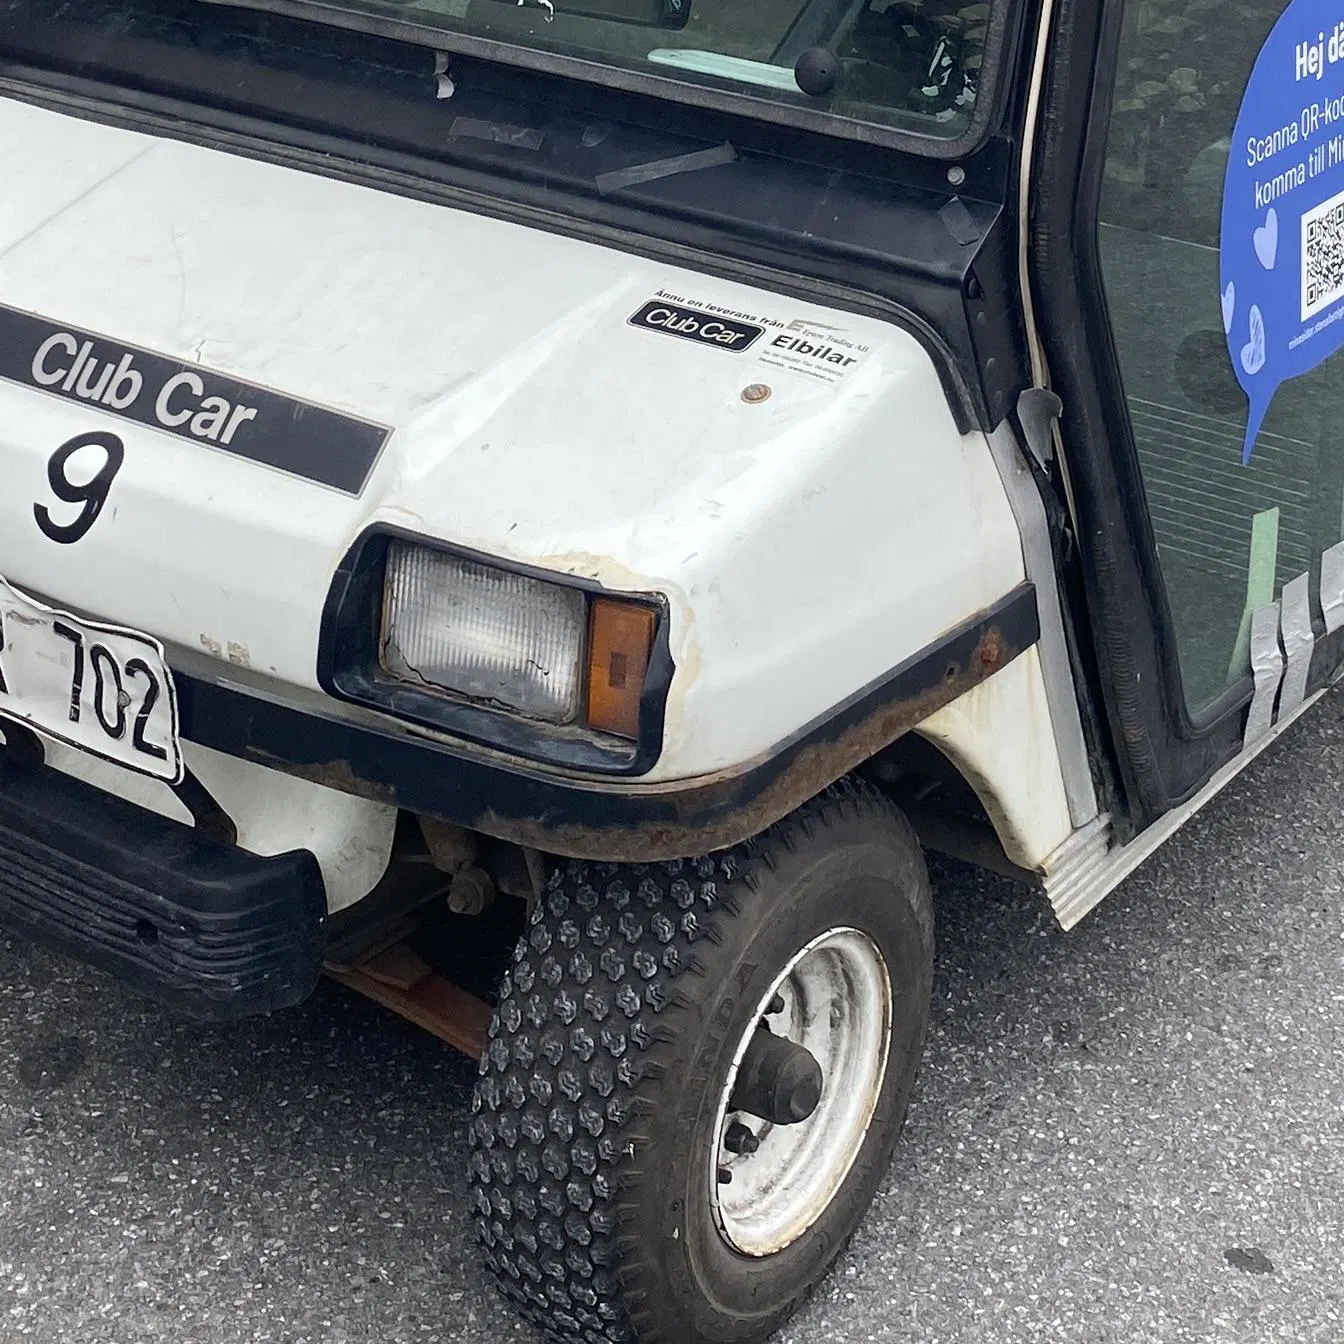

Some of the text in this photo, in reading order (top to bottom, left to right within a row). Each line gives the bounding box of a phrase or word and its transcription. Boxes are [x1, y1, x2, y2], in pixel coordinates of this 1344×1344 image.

[1295, 31, 1325, 82] Hej
[1246, 120, 1299, 168] Scanna
[1255, 162, 1306, 209] komma
[1307, 144, 1325, 178] till
[645, 308, 745, 345] Club Car
[654, 289, 785, 329] Ännu en leverans från
[770, 334, 858, 367] Elbilar
[31, 332, 258, 445] Club Car
[33, 430, 125, 545] 9
[53, 619, 168, 761] 702
